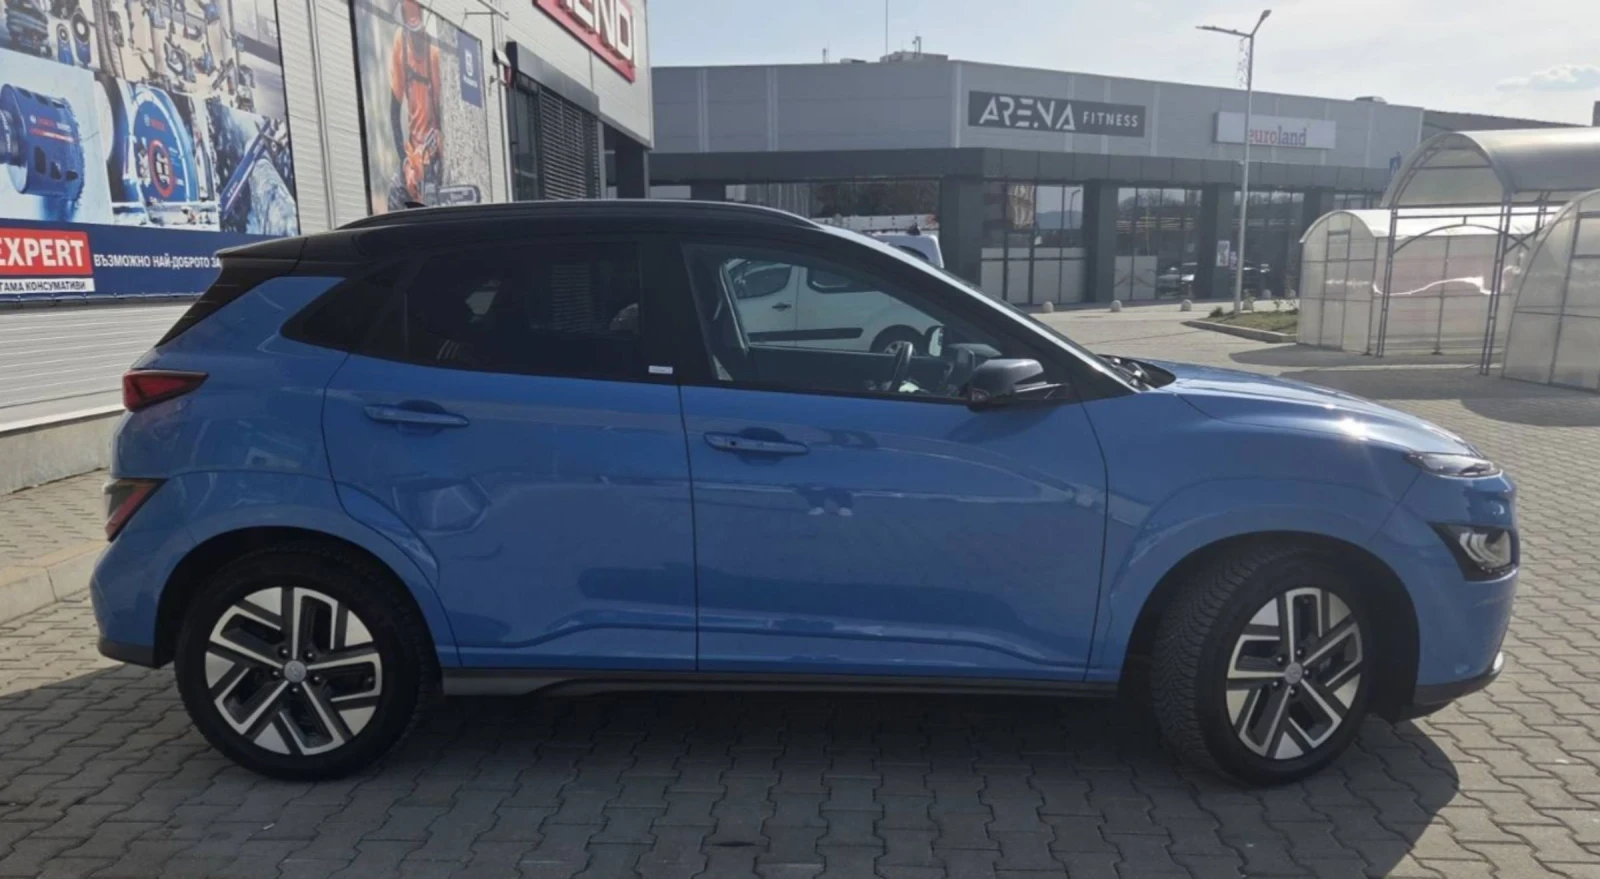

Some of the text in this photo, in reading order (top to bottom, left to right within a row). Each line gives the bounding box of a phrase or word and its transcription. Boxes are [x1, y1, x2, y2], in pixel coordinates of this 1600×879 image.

[979, 96, 1139, 131] ARENA FITNESS
[0, 237, 84, 267] EXPERT
[93, 253, 151, 268] ВЪЗМОЖНО
[152, 253, 210, 270] НАЙ-ДОБРОТО
[25, 281, 86, 292] КОНСУМАТИВИ
